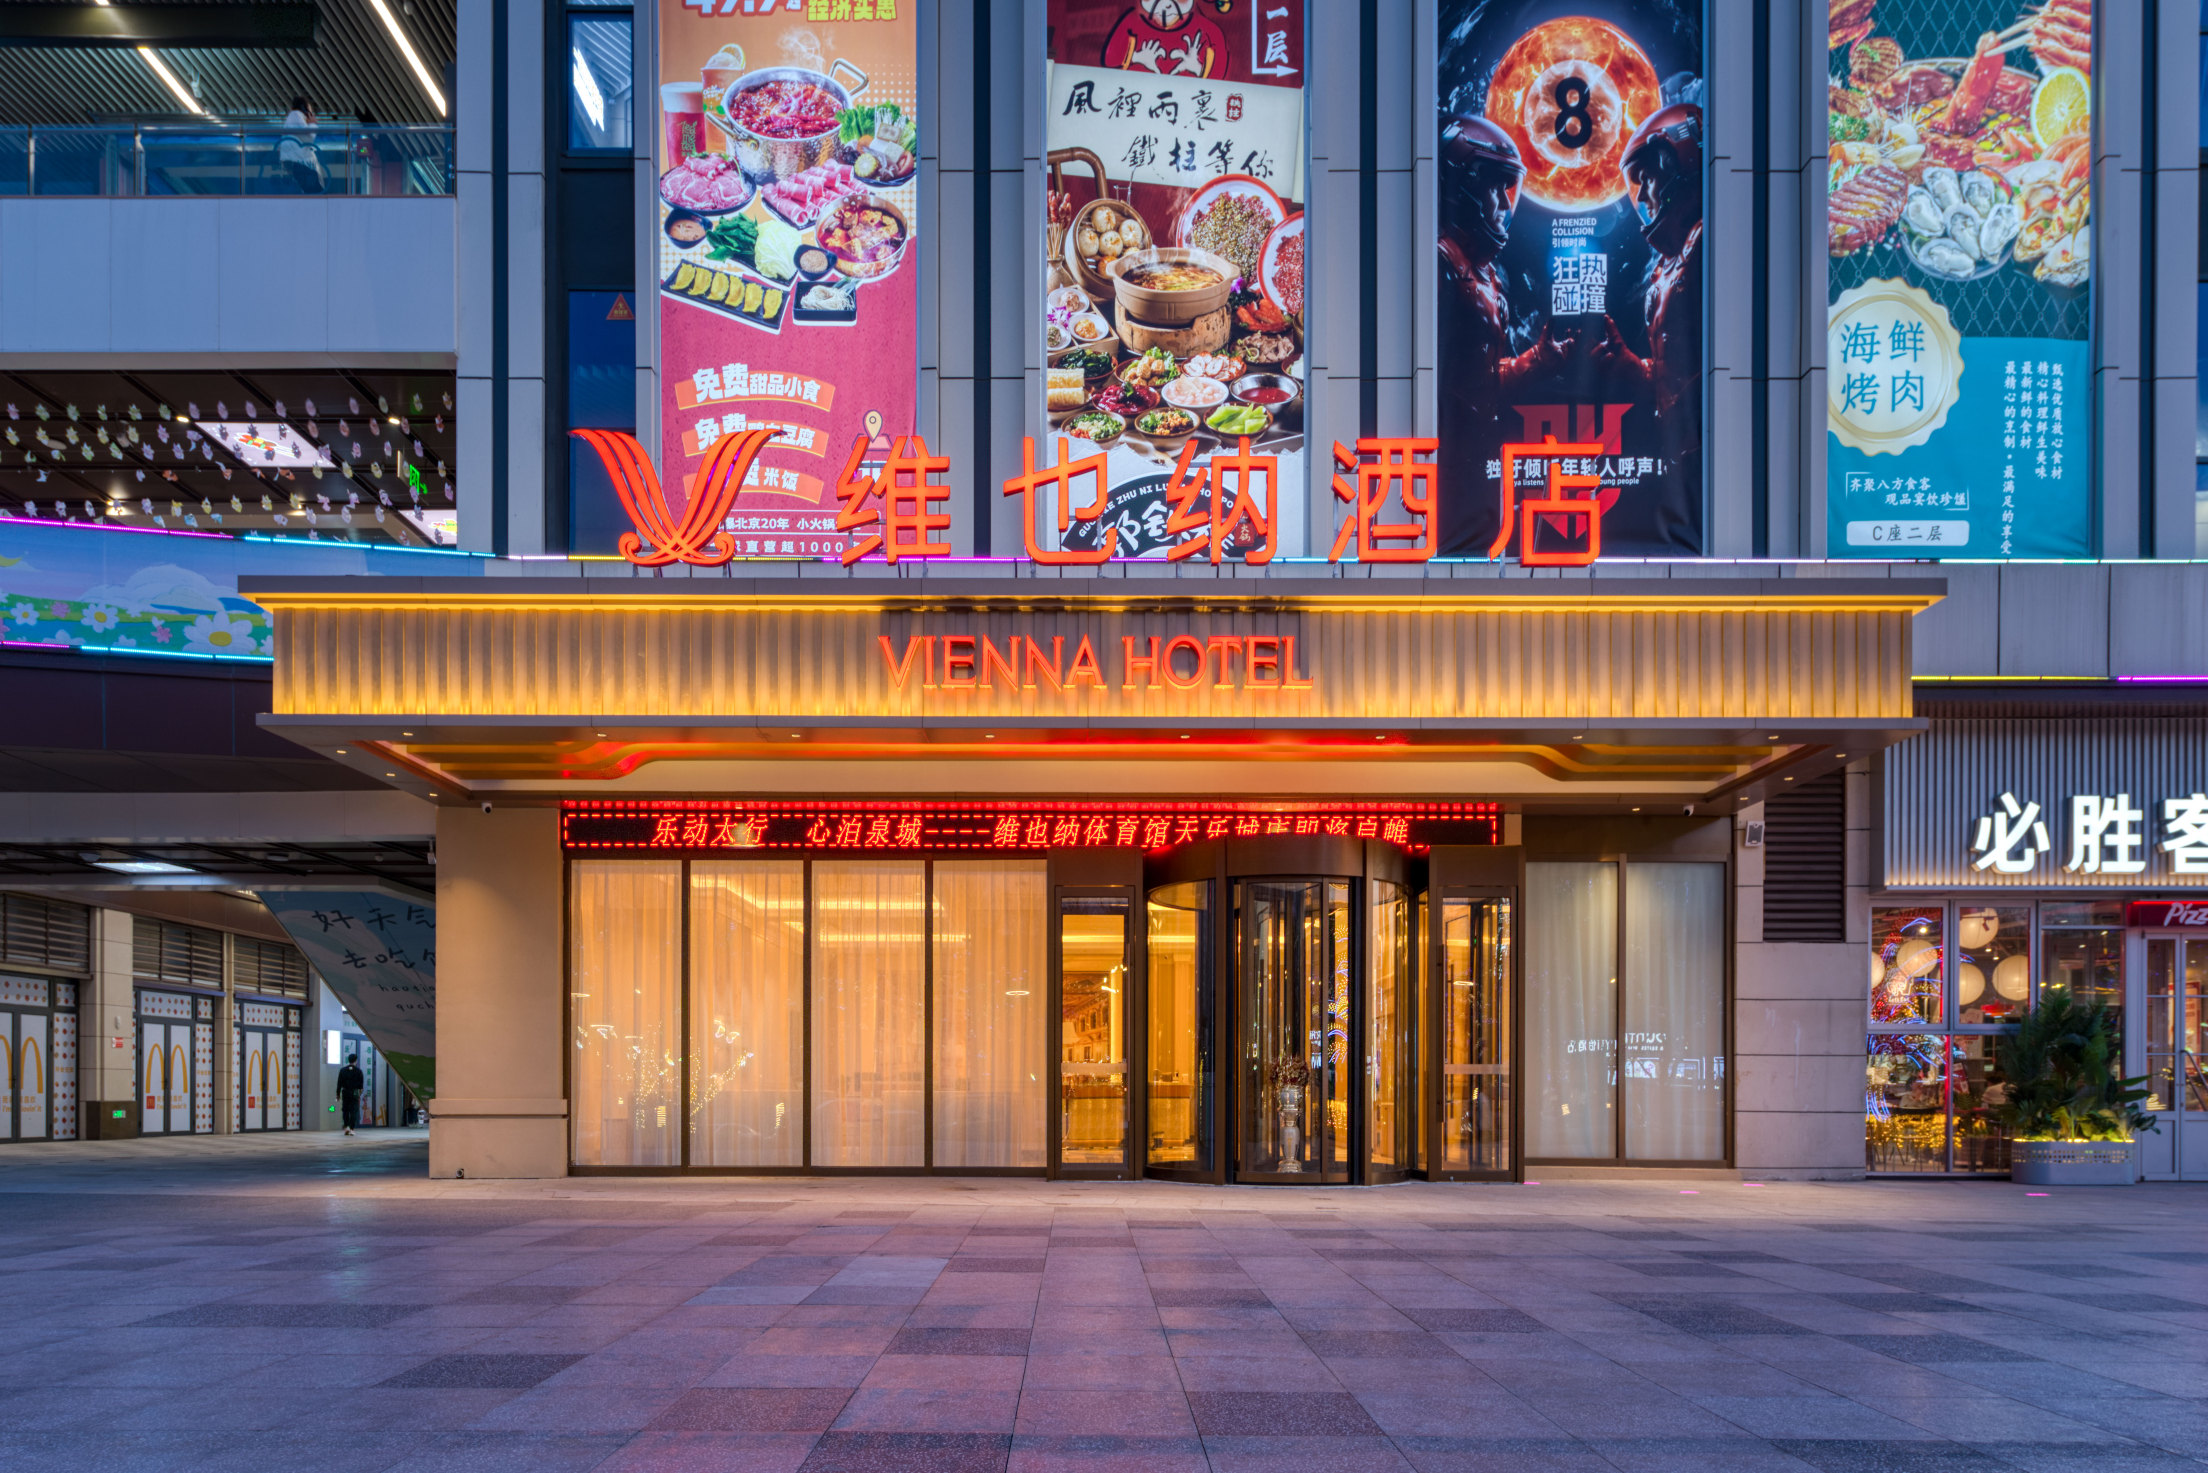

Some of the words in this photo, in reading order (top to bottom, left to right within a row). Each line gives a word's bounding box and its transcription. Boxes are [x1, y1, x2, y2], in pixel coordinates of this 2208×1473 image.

[808, 0, 897, 21] 经济实惠
[1264, 7, 1289, 64] 一层
[1554, 76, 1593, 149] 8
[1552, 219, 1558, 227] A
[1559, 218, 1597, 227] FRENZIED
[1552, 227, 1594, 236] COLLISION
[1552, 237, 1587, 248] 引领时尚
[1553, 253, 1607, 285] 狂热
[1552, 284, 1607, 315] 碰撞
[1840, 319, 1926, 364] 海鲜
[692, 362, 821, 403] 免费甜品小食
[1840, 370, 1925, 415] 烤肉
[2019, 361, 2033, 449] 最新鲜的食材
[1116, 490, 1137, 505] ZHU
[1139, 486, 1153, 495] NI
[1523, 478, 1544, 486] listens
[1617, 478, 1639, 486] people
[1850, 477, 1931, 492] 齐聚八方食客
[836, 436, 1604, 567] 维也纳酒店
[1872, 524, 1943, 542] C座二层
[878, 633, 1108, 691] VIENNA
[1122, 634, 1314, 689] HOTEL
[1971, 791, 2208, 875] 必胜客
